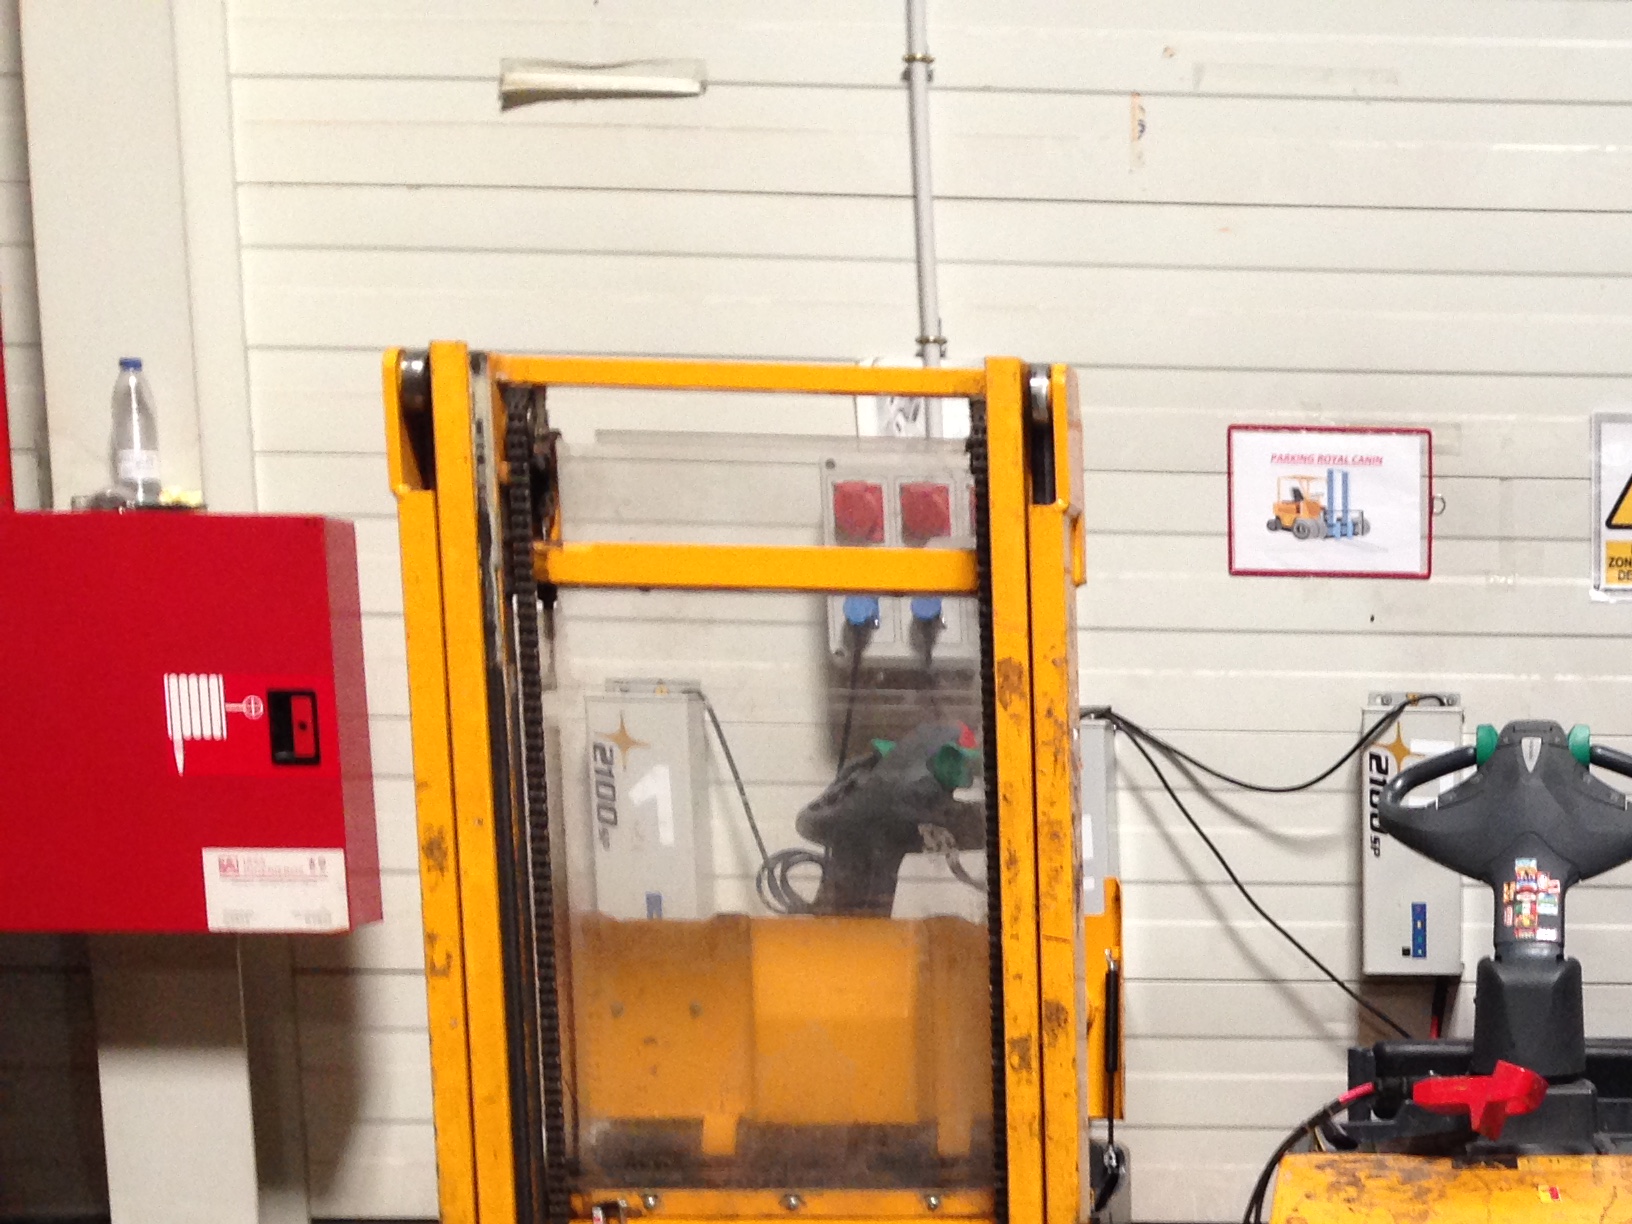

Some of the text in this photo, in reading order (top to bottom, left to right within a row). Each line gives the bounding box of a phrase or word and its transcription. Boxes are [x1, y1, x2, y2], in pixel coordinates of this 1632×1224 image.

[1270, 453, 1384, 466] PARKING ROYAL CANIN
[1617, 569, 1632, 581] DE
[593, 742, 618, 826] 2100
[627, 763, 675, 847] 1
